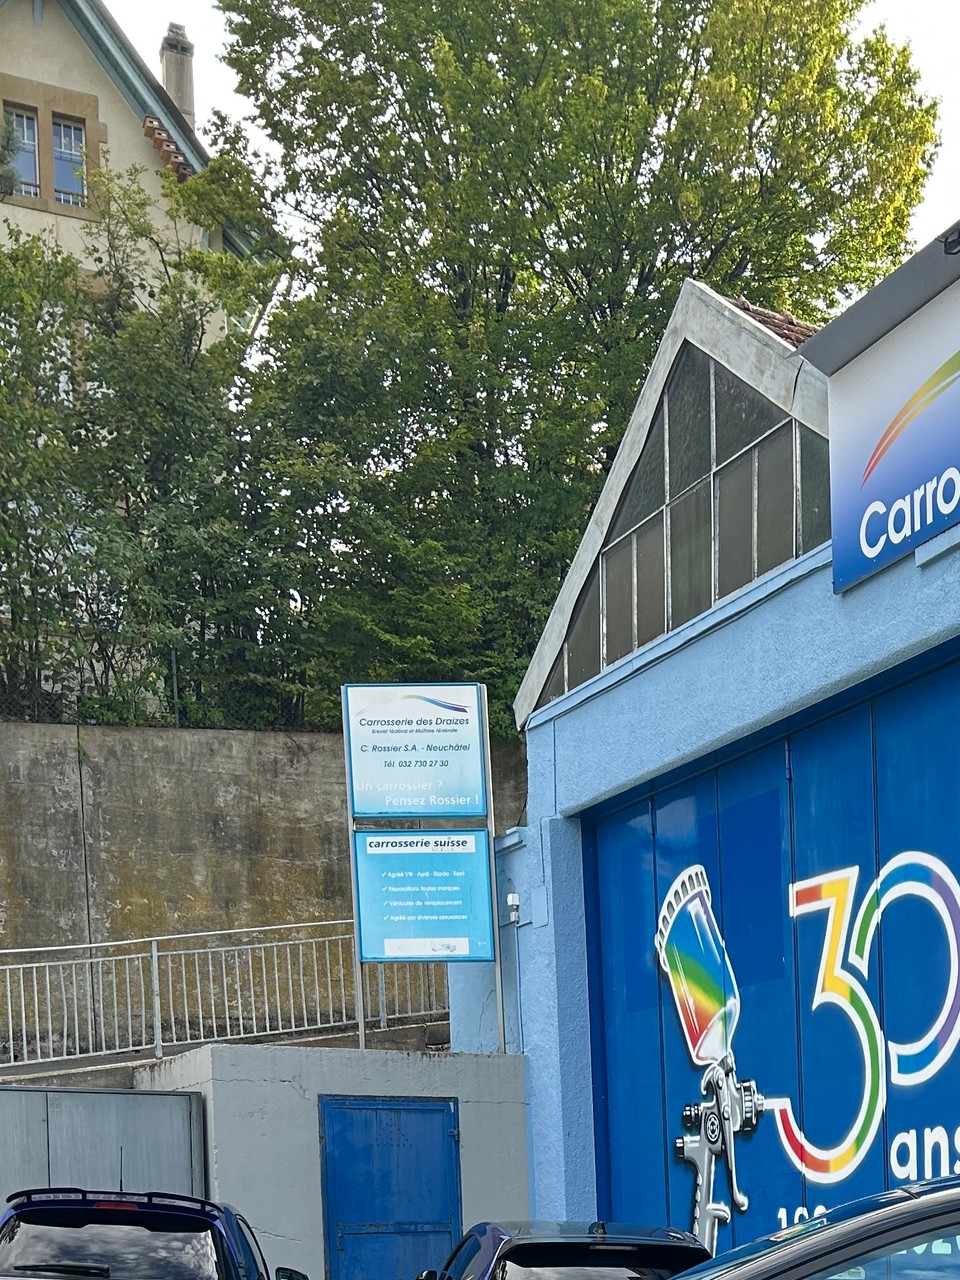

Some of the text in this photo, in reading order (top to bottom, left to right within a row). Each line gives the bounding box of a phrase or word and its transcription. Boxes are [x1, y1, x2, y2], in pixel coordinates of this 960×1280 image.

[360, 717, 469, 726] Carrosserie des Draizes
[360, 744, 369, 752] C.
[372, 744, 402, 752] Rossier
[384, 760, 395, 768] Tél.
[356, 781, 372, 791] Un
[376, 781, 432, 791] carrossier
[385, 794, 479, 806] Pensez Rossier !
[369, 837, 468, 848] carrosserie suisse
